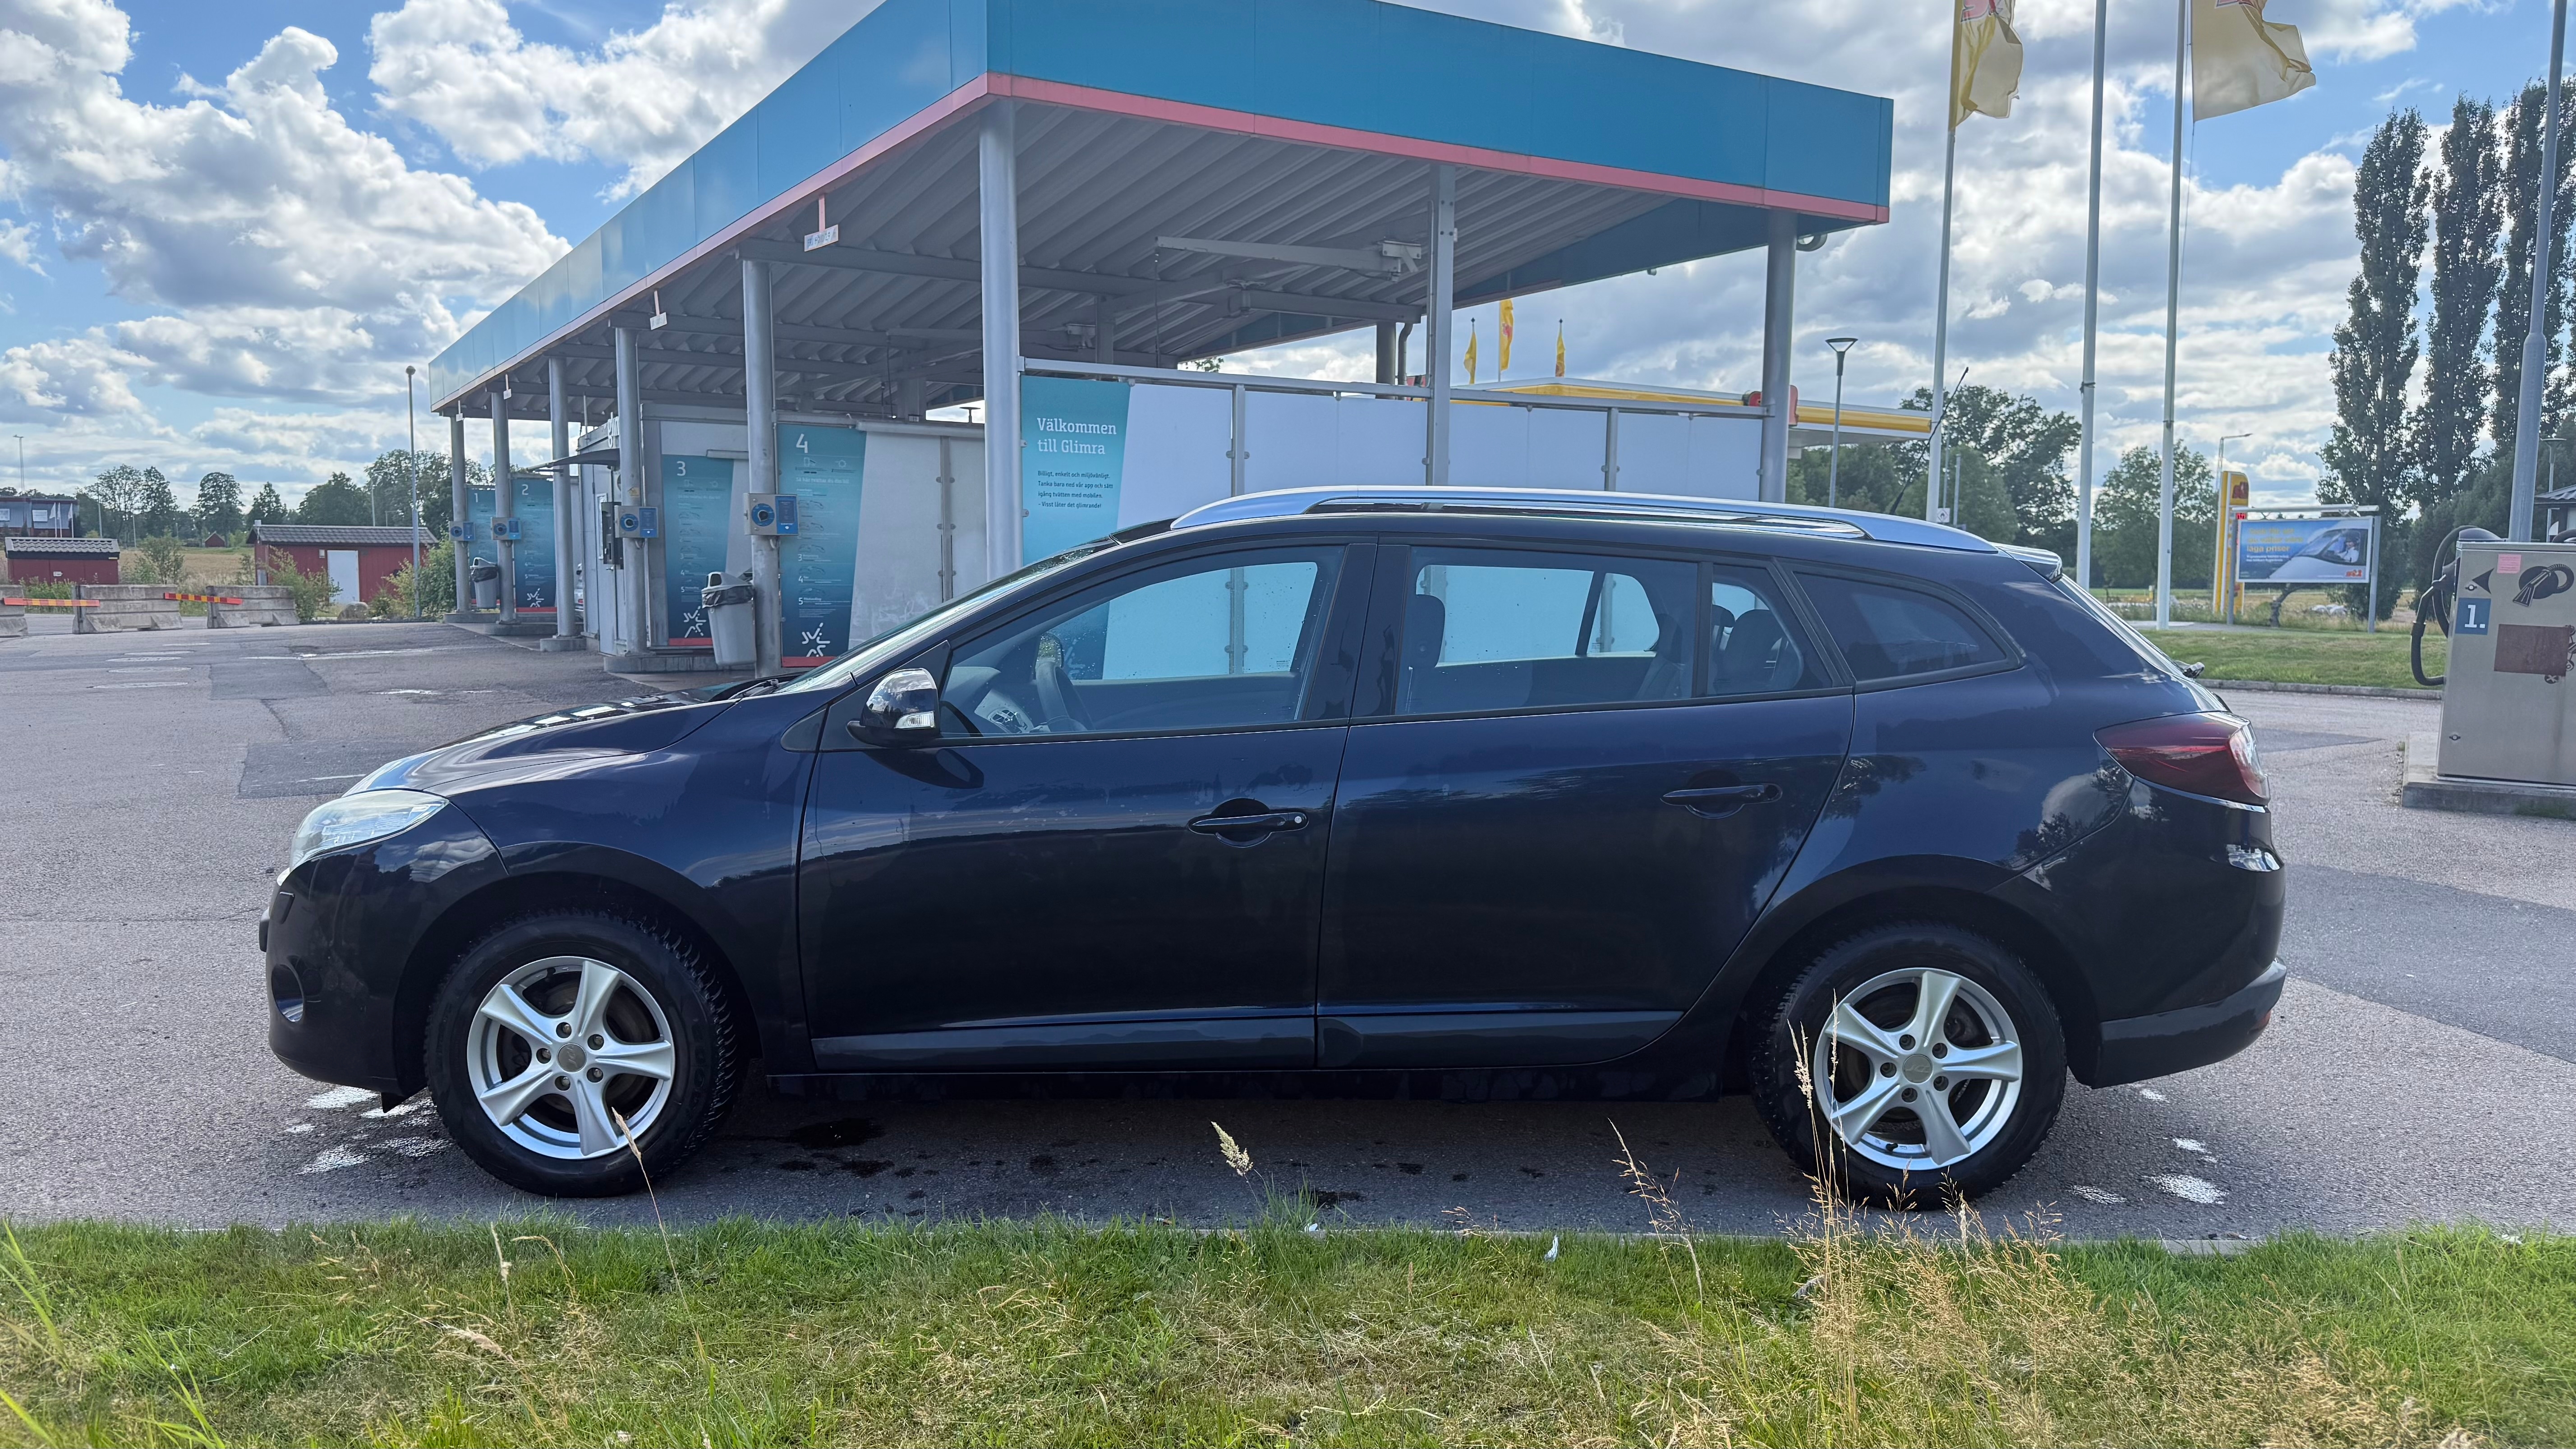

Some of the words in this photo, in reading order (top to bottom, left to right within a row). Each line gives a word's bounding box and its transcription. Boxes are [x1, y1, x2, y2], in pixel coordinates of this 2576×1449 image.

[607, 412, 619, 448] glim
[1037, 418, 1117, 435] Välkommen
[796, 433, 808, 453] 4
[1038, 439, 1057, 452] till
[1062, 440, 1105, 455] Glimra
[677, 461, 686, 476] 3
[522, 484, 529, 495] 2
[474, 493, 478, 503] 1
[2465, 604, 2486, 629] 1.
